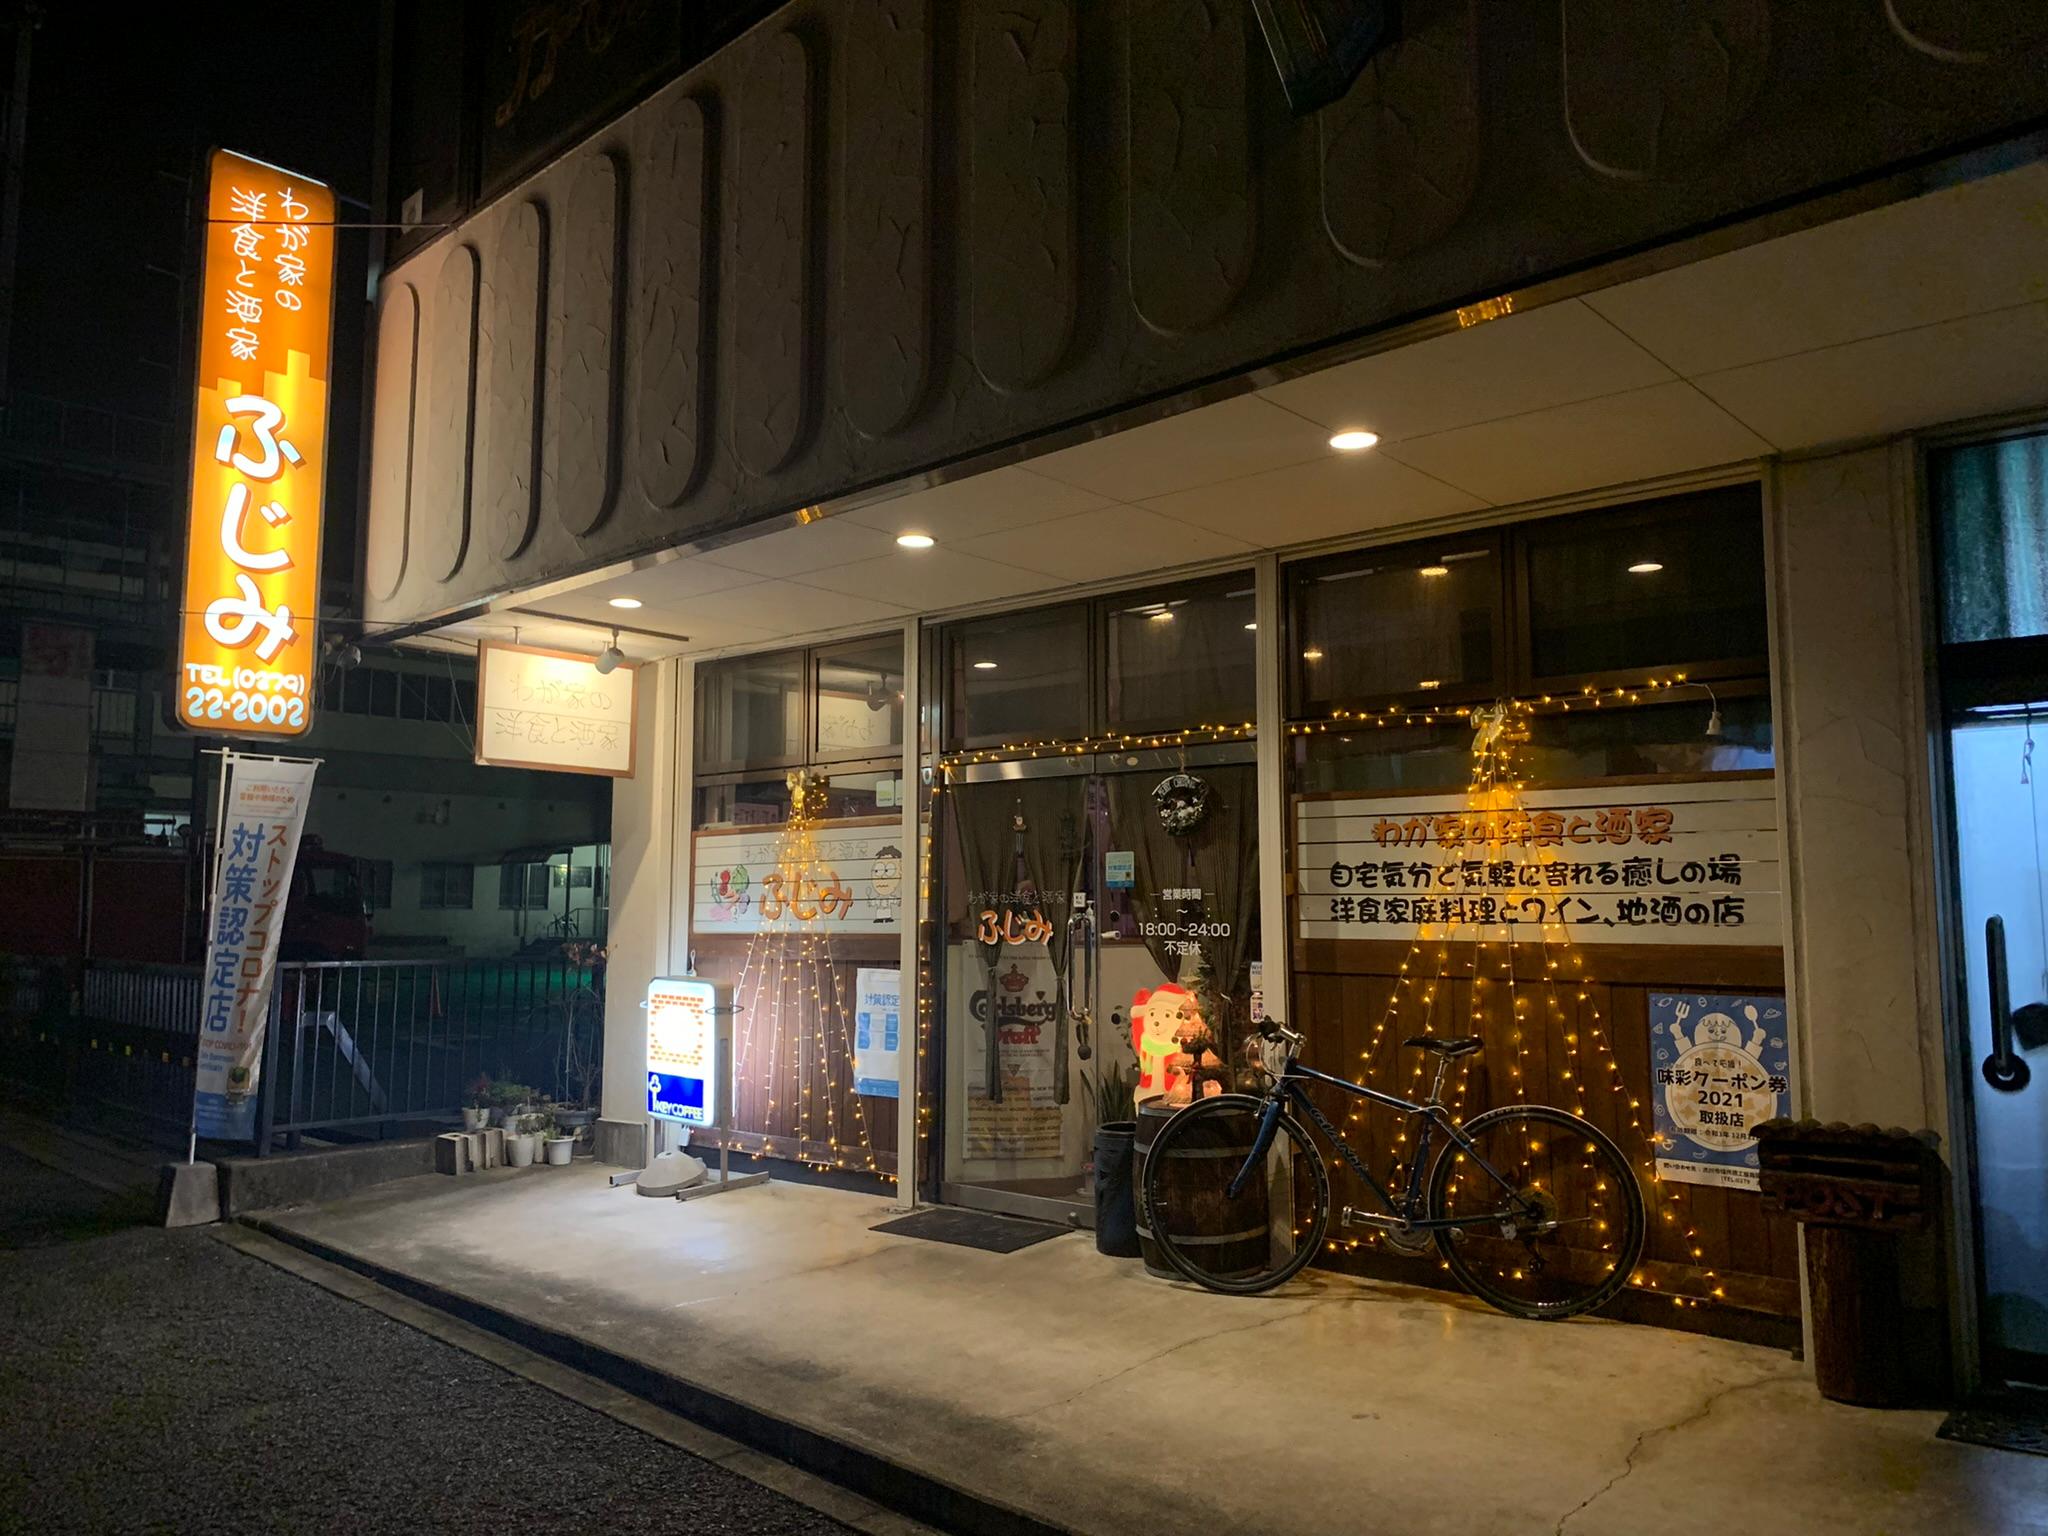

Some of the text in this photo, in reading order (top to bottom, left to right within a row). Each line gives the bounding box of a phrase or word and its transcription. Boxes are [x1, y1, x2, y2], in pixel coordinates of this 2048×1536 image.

[275, 187, 310, 311] わが家の
[225, 186, 268, 360] 洋食と酒家
[204, 395, 304, 665] ふじみ
[510, 673, 612, 710] わが家の
[496, 711, 618, 750] 洋食と酒家
[1370, 807, 1674, 848] わが家の洋食と酒家
[1330, 853, 1742, 889] 自宅気分で気軽に寄れる癒しの場
[759, 871, 854, 921] ふじみ
[1163, 888, 1202, 900] 営業時間
[1330, 896, 1745, 928] 洋食家庭料理とワイン、地酒の店
[205, 822, 265, 1033] 対策認定店
[977, 909, 1054, 945] ふじみ
[1164, 940, 1202, 956] 不定休
[1657, 1068, 1788, 1094] 味彩クーポン券
[1698, 1090, 1744, 1108] 2021
[1699, 1110, 1744, 1128] 取扱店
